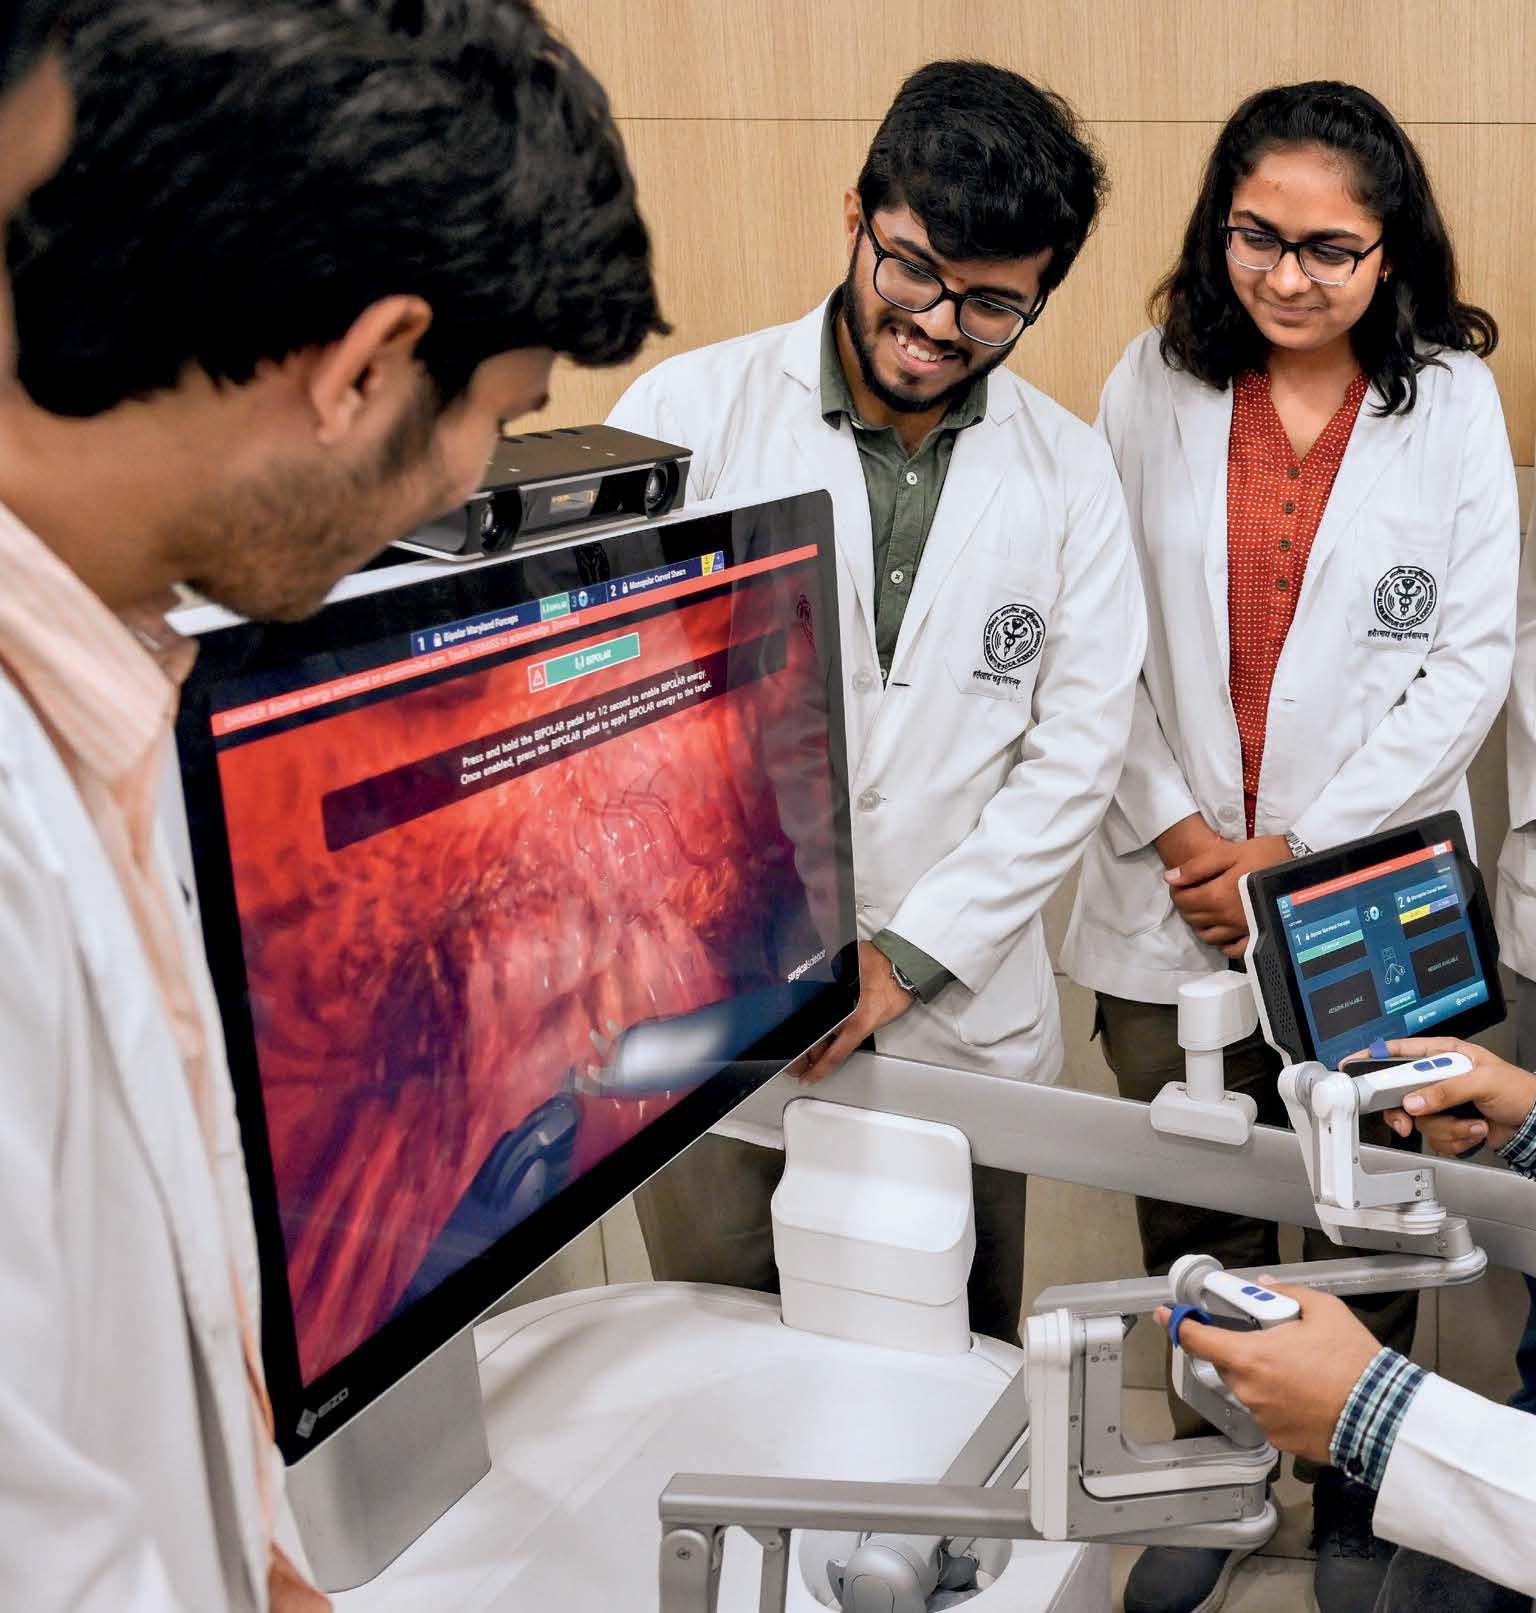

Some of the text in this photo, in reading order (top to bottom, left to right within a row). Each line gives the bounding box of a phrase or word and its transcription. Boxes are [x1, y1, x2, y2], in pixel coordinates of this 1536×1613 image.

[610, 584, 617, 598] 2
[654, 573, 671, 585] Curved
[671, 568, 687, 580] Shears
[417, 614, 519, 651] 1 Bipolar Maryland Forceps
[586, 649, 611, 666] BIPOLAR
[460, 680, 713, 784] Once enabled, press the BIPOLAR pedal to apply BIPOLAR energy to the target.
[462, 669, 707, 768] Press and hold the BIPOLAR pedal for 1/2 second to enable BIPOLAR energy.
[1363, 910, 1371, 922] 3
[1397, 896, 1405, 908] 2
[1296, 934, 1302, 945] 1
[787, 949, 826, 983] surgicalscience
